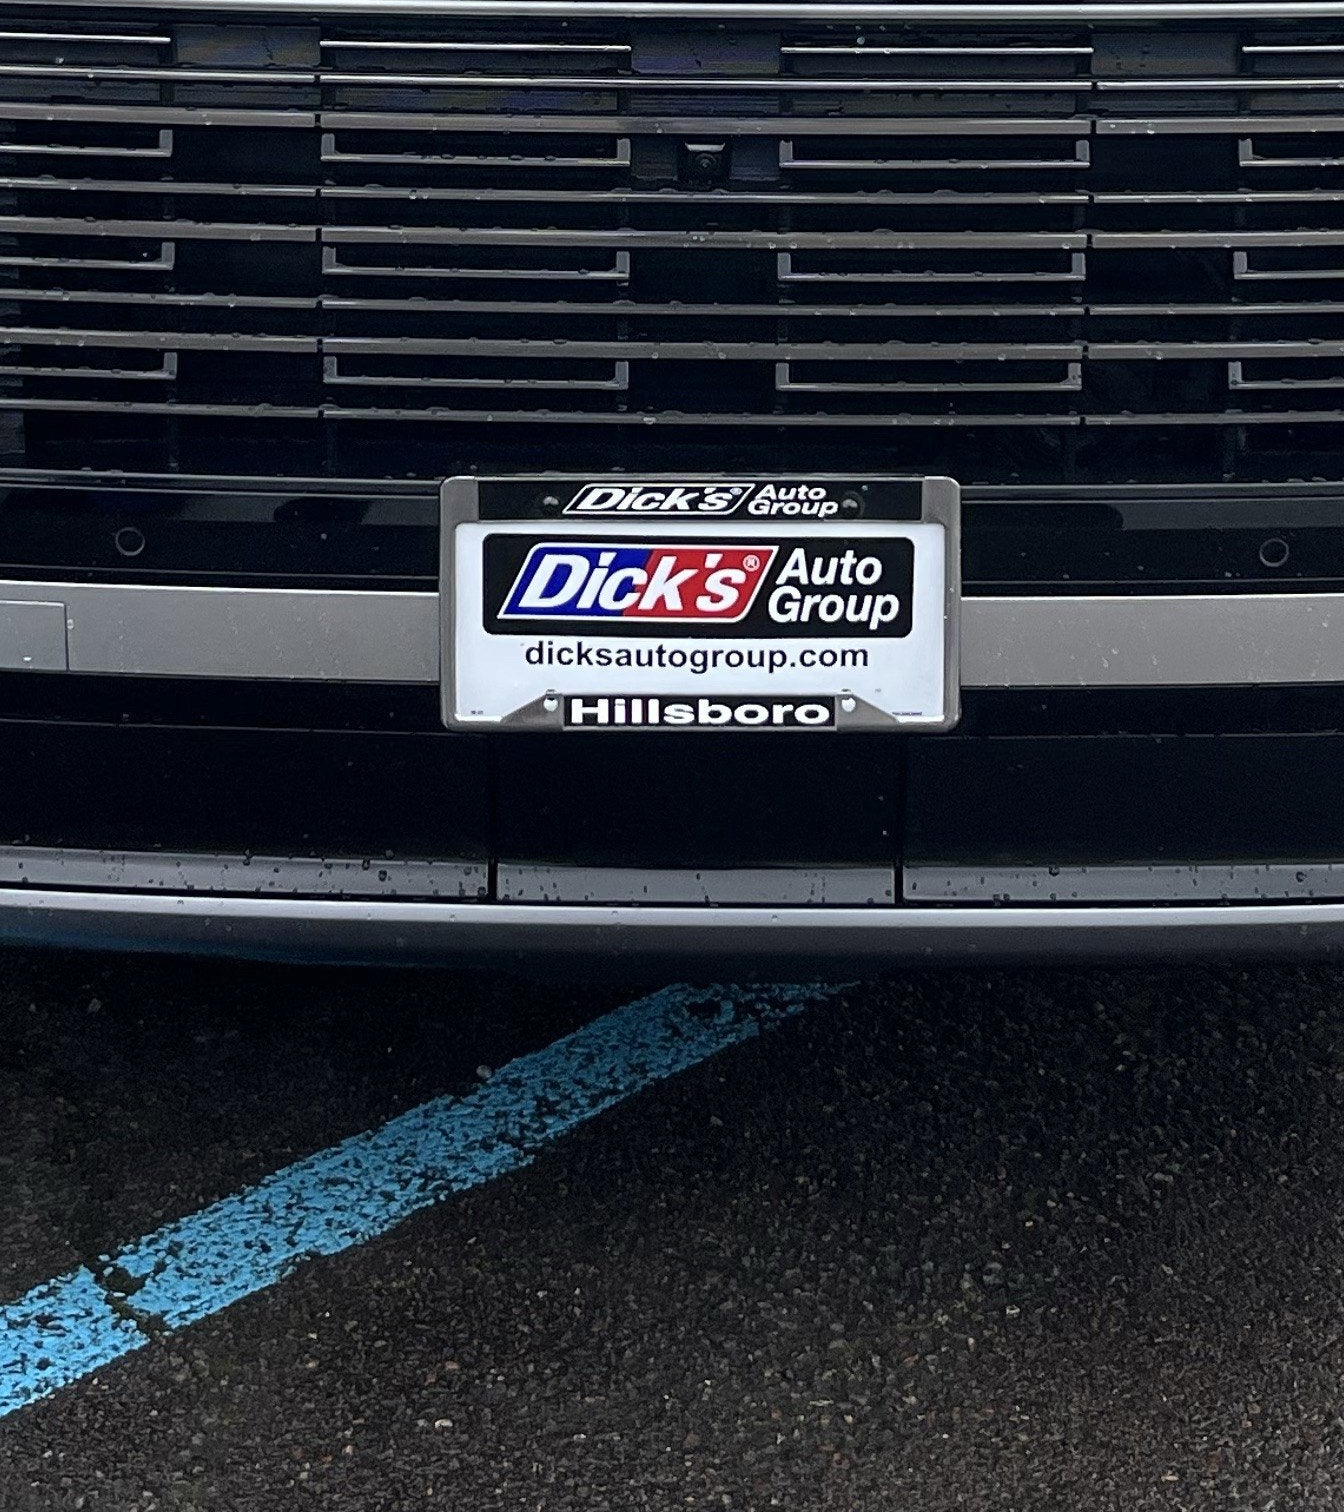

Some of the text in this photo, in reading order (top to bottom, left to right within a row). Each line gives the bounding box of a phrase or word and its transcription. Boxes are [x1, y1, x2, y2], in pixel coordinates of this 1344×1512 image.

[755, 484, 827, 501] Auto
[747, 499, 839, 518] Group
[775, 547, 883, 586] Auto
[767, 586, 900, 631] Group
[525, 640, 869, 675] dicksautogroup.com
[571, 698, 829, 725] Hillsboro
